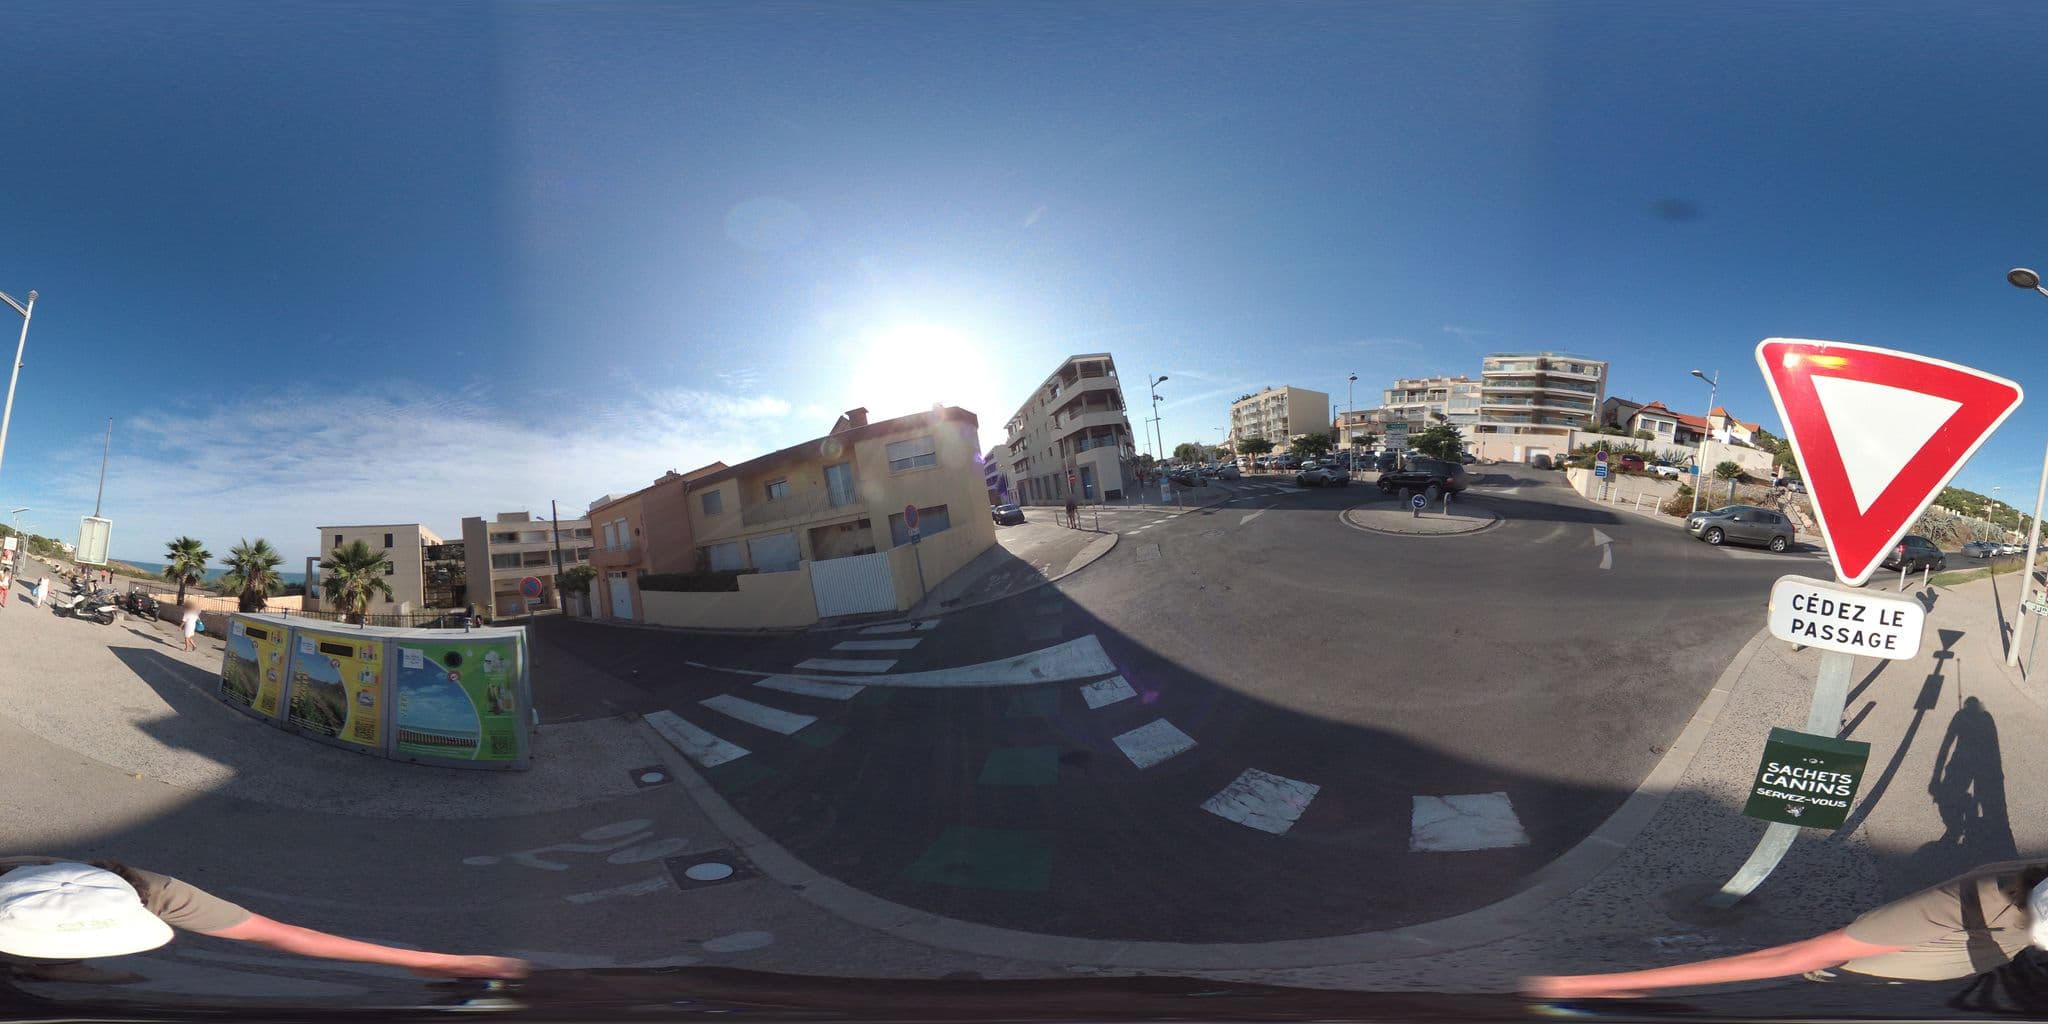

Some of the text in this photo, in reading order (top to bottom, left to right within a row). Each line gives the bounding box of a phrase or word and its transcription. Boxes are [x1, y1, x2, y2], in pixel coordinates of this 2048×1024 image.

[1792, 593, 1905, 627] CÉDEZ LE
[1791, 619, 1897, 650] PASSAGE
[1762, 773, 1851, 796] CANINS
[1767, 762, 1852, 784] SACHETS
[1756, 787, 1848, 808] SERVEZ-VOUS
